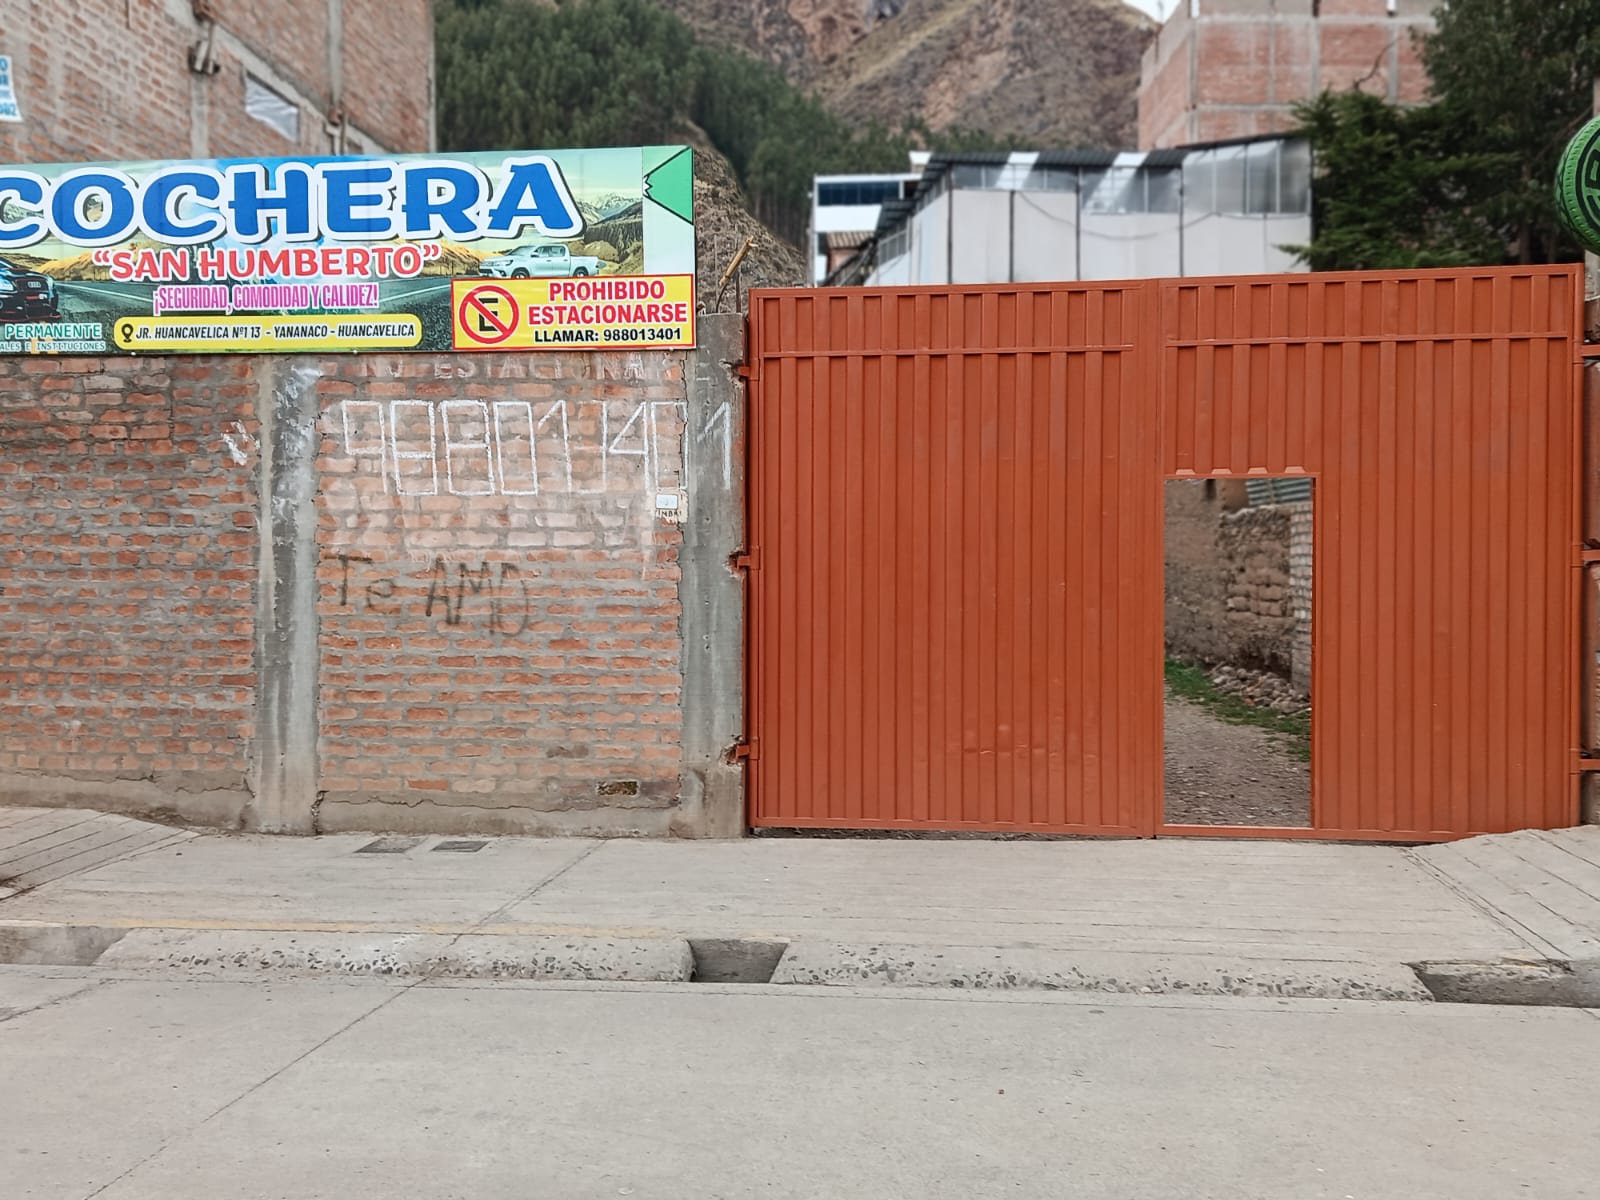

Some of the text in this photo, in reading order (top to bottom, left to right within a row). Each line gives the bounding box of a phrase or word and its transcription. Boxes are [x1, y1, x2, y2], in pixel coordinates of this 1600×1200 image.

[0, 158, 577, 244] COCHERA
[234, 284, 309, 309] COMODIDAD
[311, 284, 320, 308] Y
[322, 283, 379, 308] CALIDEZ!
[549, 280, 665, 301] PROHIBIDO
[528, 302, 688, 326] ESTACIONARSE
[5, 323, 102, 338] PERMANENTE
[135, 327, 152, 339] JR.
[154, 326, 229, 339] HUANCAVELICA
[274, 324, 328, 338] YANANACO
[338, 324, 415, 337] HUANCAVELICA
[534, 327, 681, 343] LLAMAR: 988013401
[37, 340, 105, 350] INSTITUCIONES
